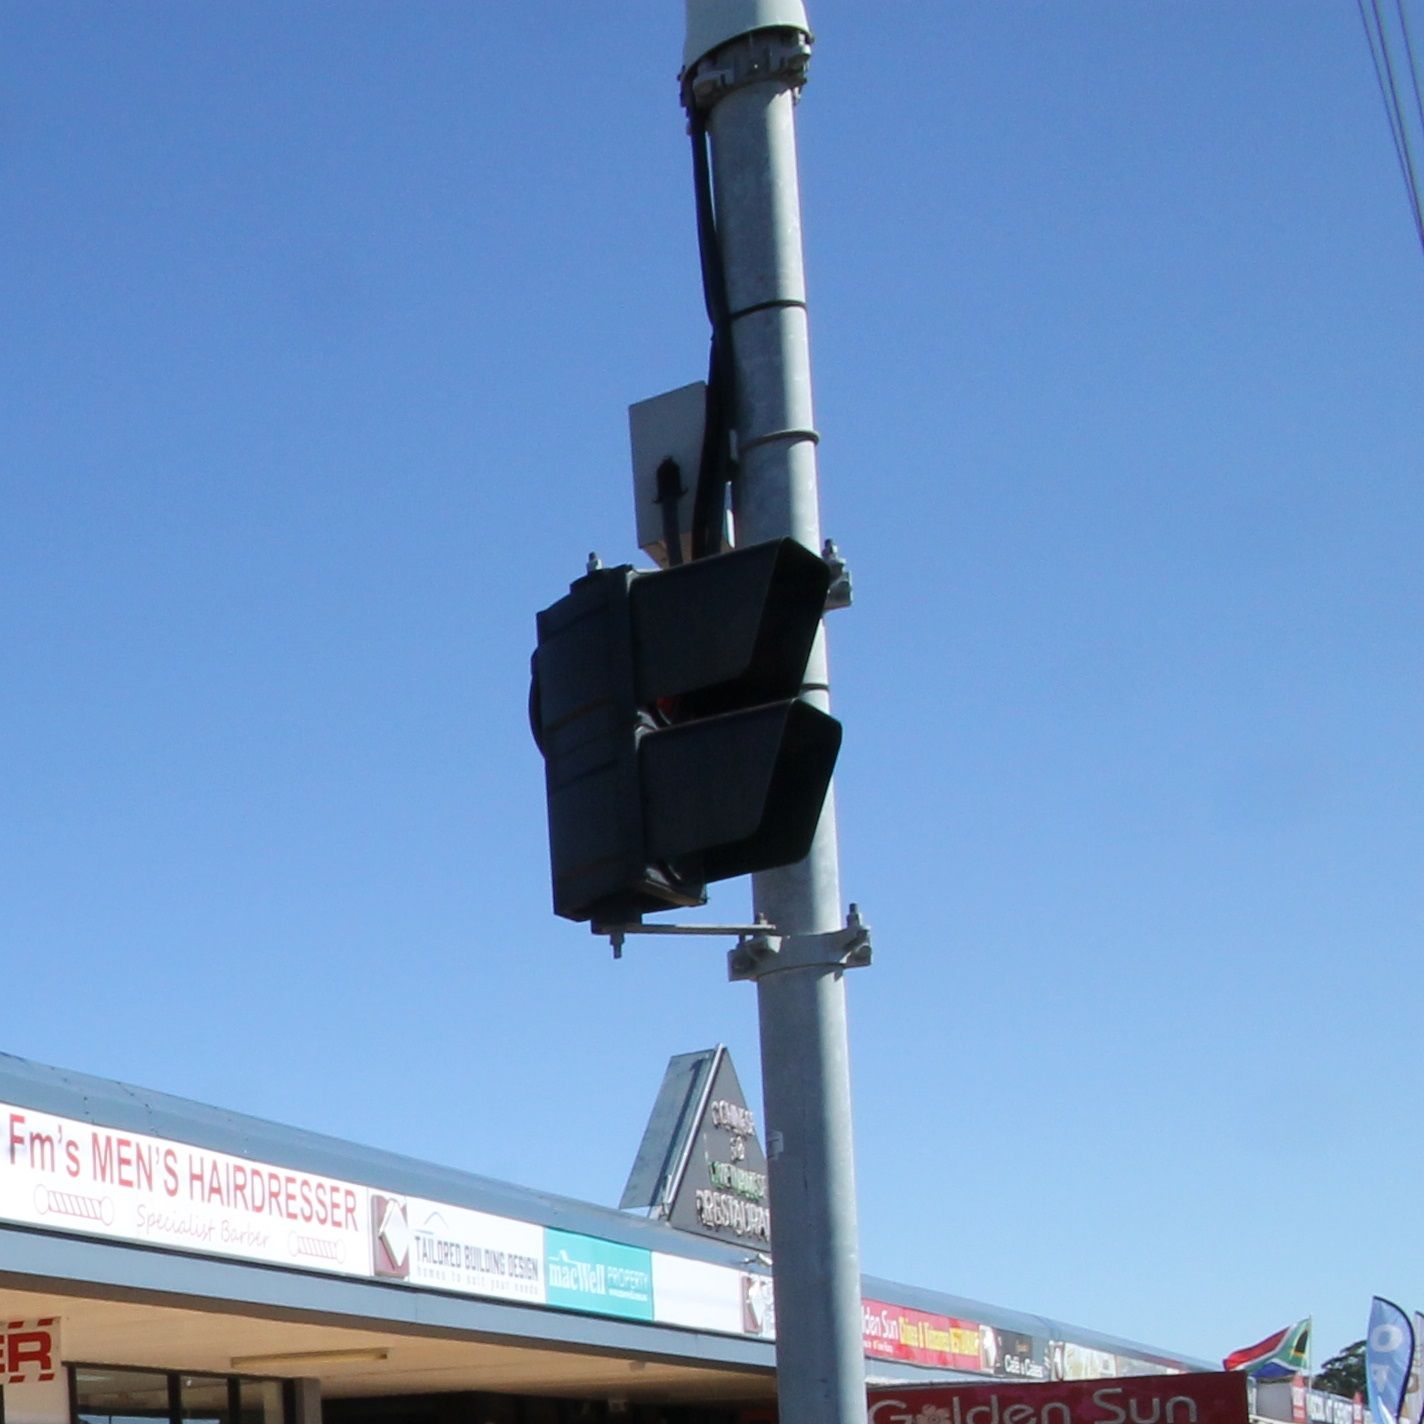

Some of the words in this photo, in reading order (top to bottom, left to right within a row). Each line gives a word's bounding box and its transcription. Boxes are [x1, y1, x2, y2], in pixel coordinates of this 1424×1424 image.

[9, 1113, 80, 1178] Fm's
[92, 1132, 179, 1198] MEN'S
[189, 1156, 358, 1232] HAIRDRESSER
[137, 1203, 214, 1243] Specialist
[220, 1218, 272, 1249] Barber
[414, 1235, 461, 1269] TAILORED
[464, 1245, 506, 1276] BUILDING
[508, 1253, 539, 1281] DESIGN
[549, 1263, 606, 1295] macWell
[607, 1266, 648, 1290] PROPERTY
[881, 1310, 898, 1339] Sun
